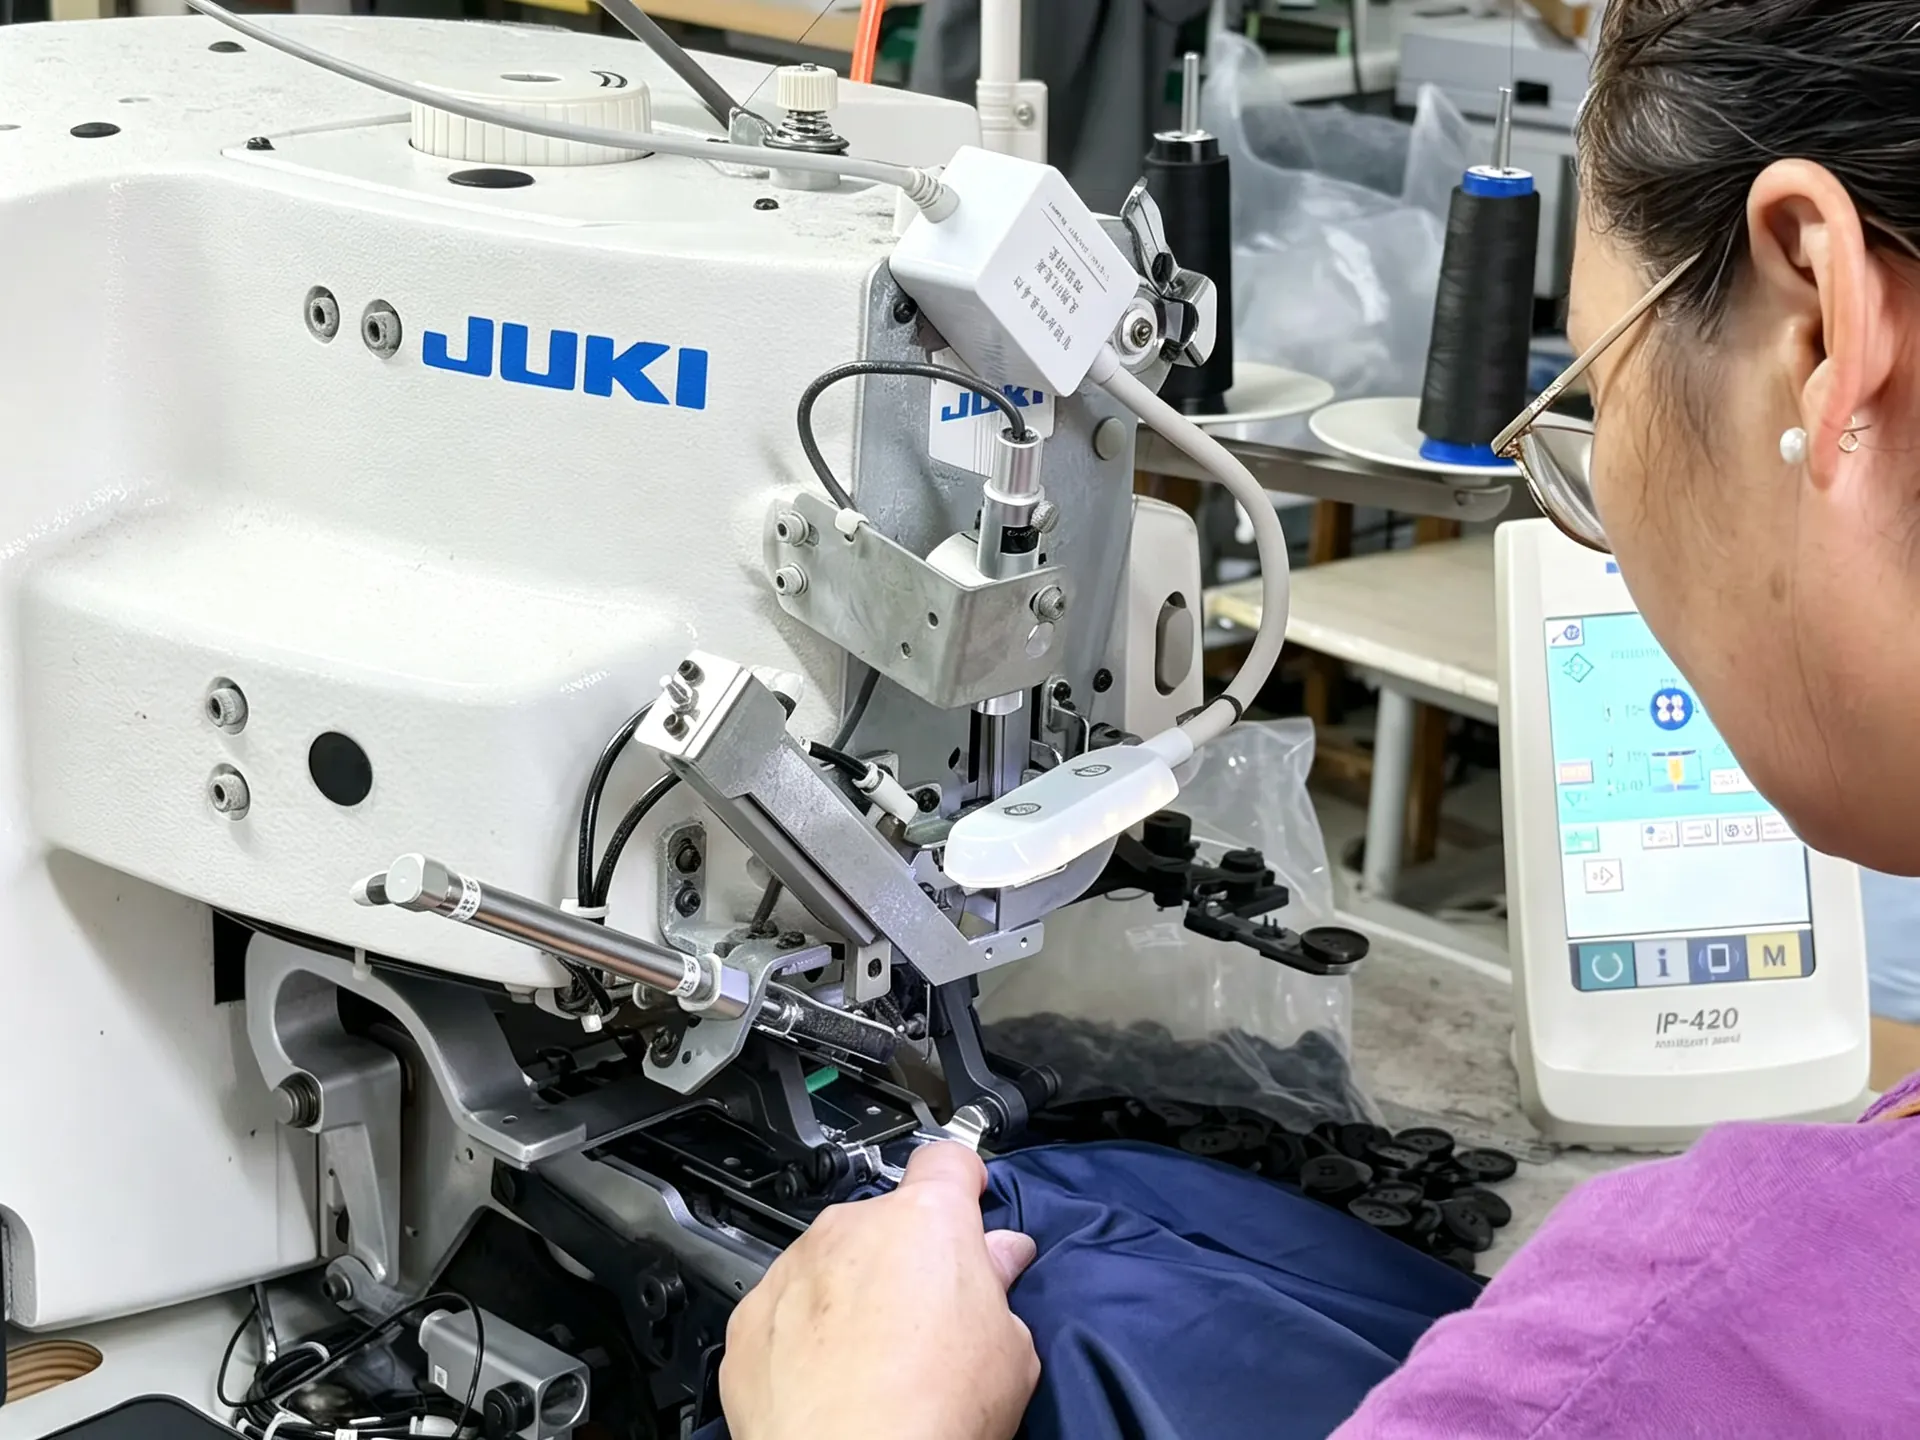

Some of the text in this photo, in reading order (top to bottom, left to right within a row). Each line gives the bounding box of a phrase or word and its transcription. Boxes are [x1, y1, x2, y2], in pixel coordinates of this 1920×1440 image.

[422, 316, 708, 410] JUKI
[1763, 945, 1786, 966] M
[1656, 1008, 1738, 1034] IP-420
